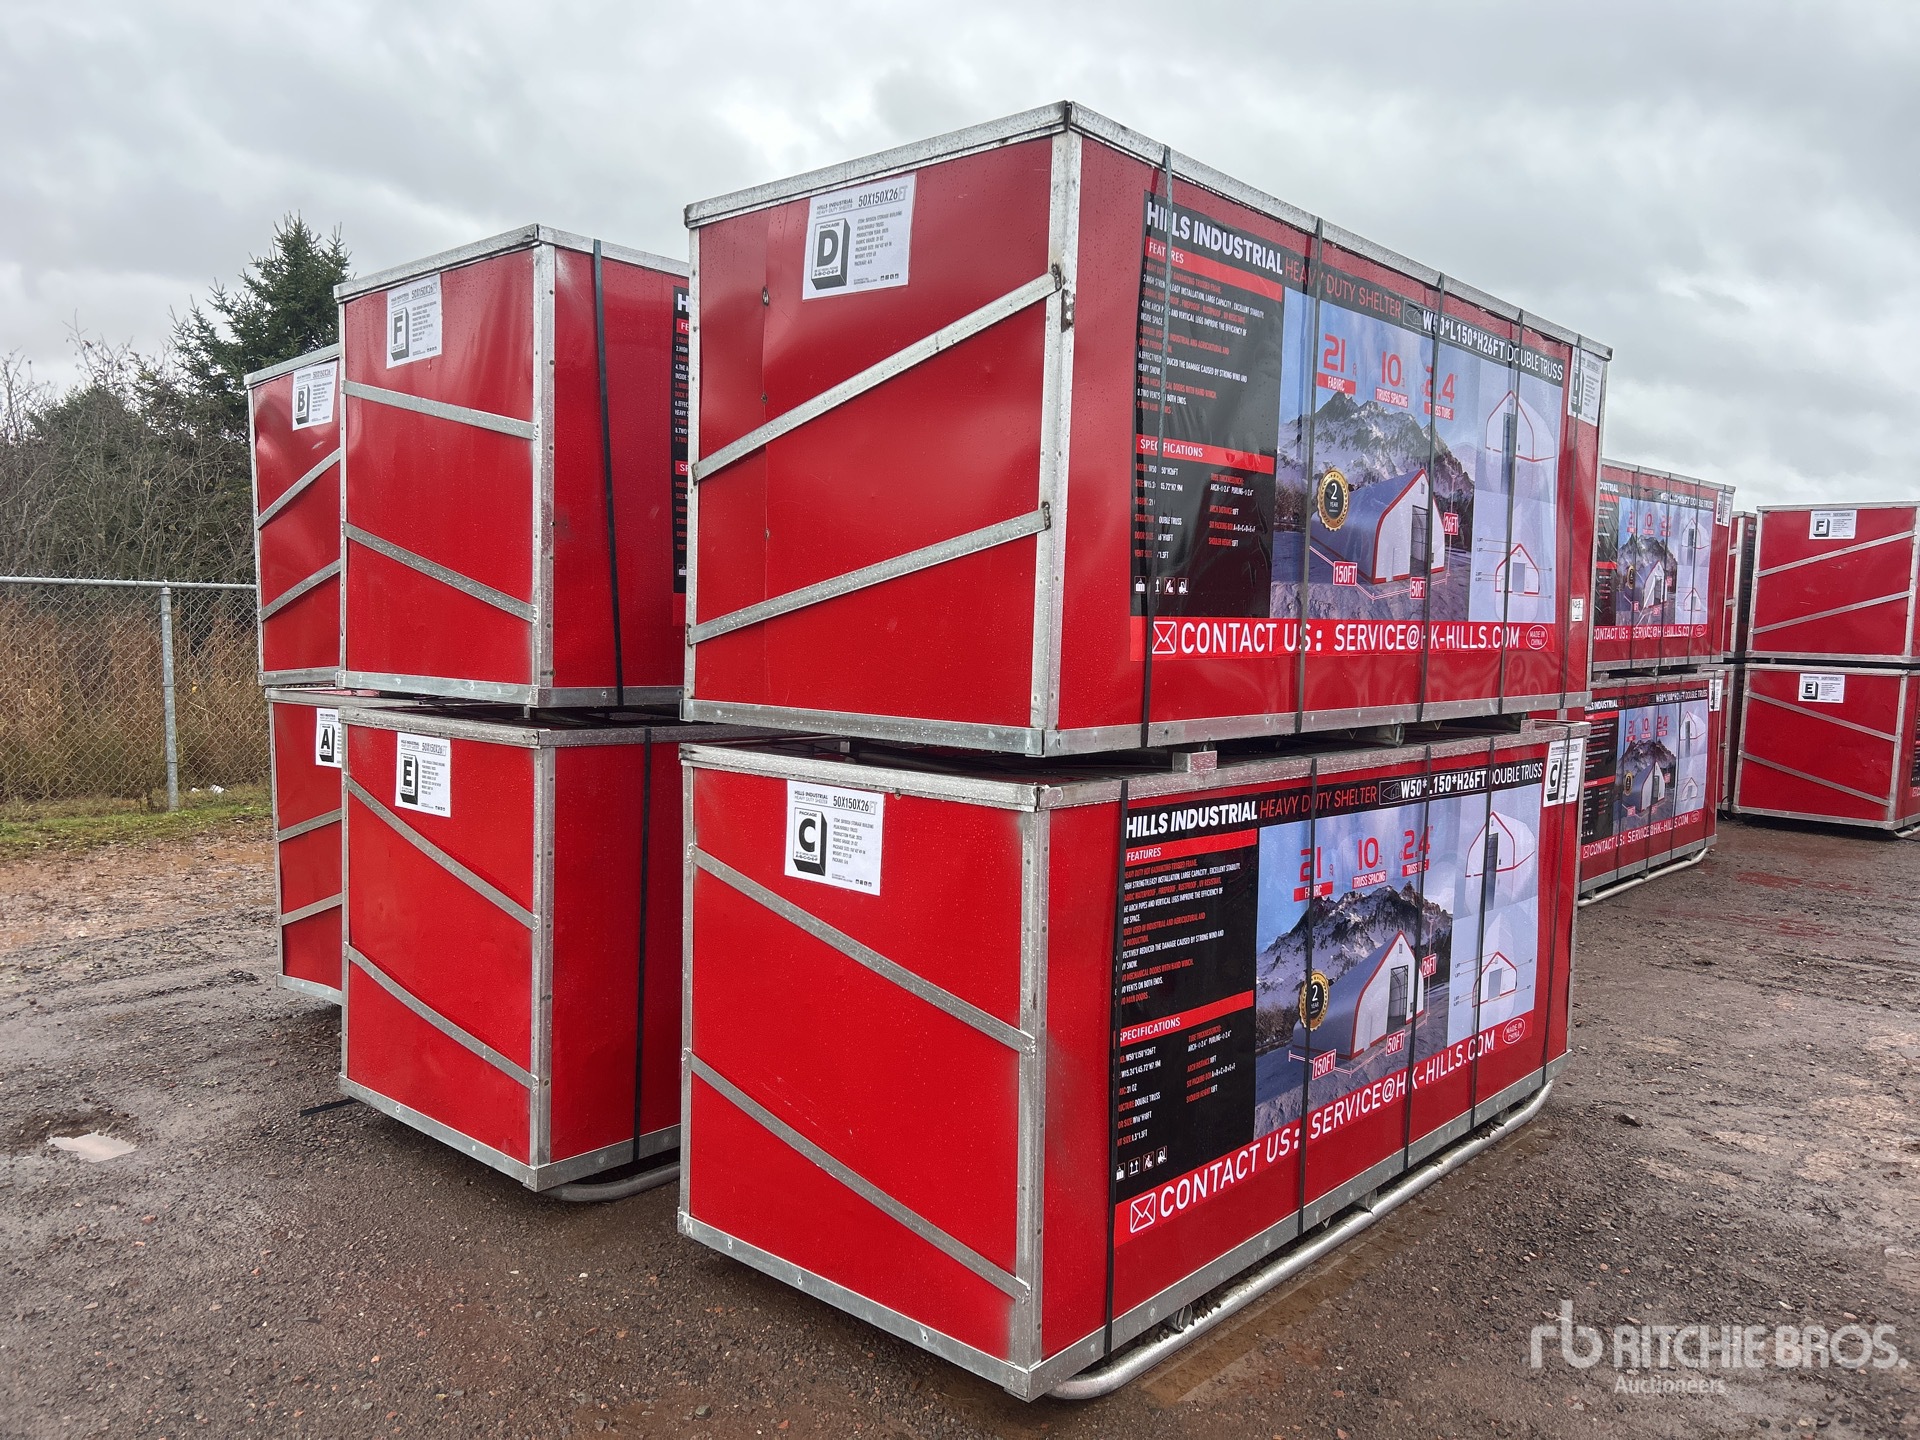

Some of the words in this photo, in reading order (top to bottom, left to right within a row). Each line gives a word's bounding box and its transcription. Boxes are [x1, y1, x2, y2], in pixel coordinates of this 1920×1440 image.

[819, 221, 840, 230] PACKAGE
[816, 228, 839, 268] D
[1149, 241, 1184, 264] FEATRES
[1193, 220, 1283, 275] INDUSTRIAL
[1285, 256, 1324, 288] HEAV
[1326, 273, 1357, 303] DUTY
[1359, 286, 1401, 318] SHELTER
[1540, 357, 1563, 381] TRUSS
[393, 314, 404, 345] F
[1323, 333, 1346, 373] 21
[1381, 350, 1403, 387] 10
[297, 390, 306, 412] B
[1140, 438, 1204, 457] SPECFICATIONS
[1330, 482, 1338, 501] 2
[1444, 515, 1458, 535] 26FT
[1815, 520, 1825, 532] F
[1335, 565, 1357, 584] 150FT
[1411, 582, 1426, 598] 50FT
[1181, 622, 1278, 653] CONTACT
[1530, 637, 1543, 646] CHINA
[1618, 627, 1628, 638] US:
[1804, 683, 1814, 694] E
[1594, 700, 1618, 710] INDUSTRIAL
[320, 728, 331, 750] A
[403, 759, 413, 788] E
[1549, 763, 1559, 788] C
[1126, 812, 1169, 839] HILLS
[1170, 801, 1258, 832] INDUSTRIAL
[1260, 796, 1299, 819] HEAVY
[1334, 786, 1377, 809] SHELTER
[1521, 762, 1543, 780] TRUSS
[798, 810, 818, 818] PACKAGE
[798, 817, 816, 853] C
[1126, 847, 1162, 861] FEATURES
[1357, 837, 1379, 870] 10
[1590, 837, 1614, 856] CONTACT
[1299, 846, 1322, 883] 21
[1353, 876, 1368, 887] TRUSS
[1368, 871, 1386, 883] SPACING
[1422, 956, 1436, 977] 26FT
[1311, 984, 1318, 1002] 2
[1387, 1033, 1404, 1054] 50FT
[1314, 1053, 1335, 1077] 150FT
[1160, 1143, 1261, 1218] CONTACT
[1266, 1127, 1300, 1163] US:
